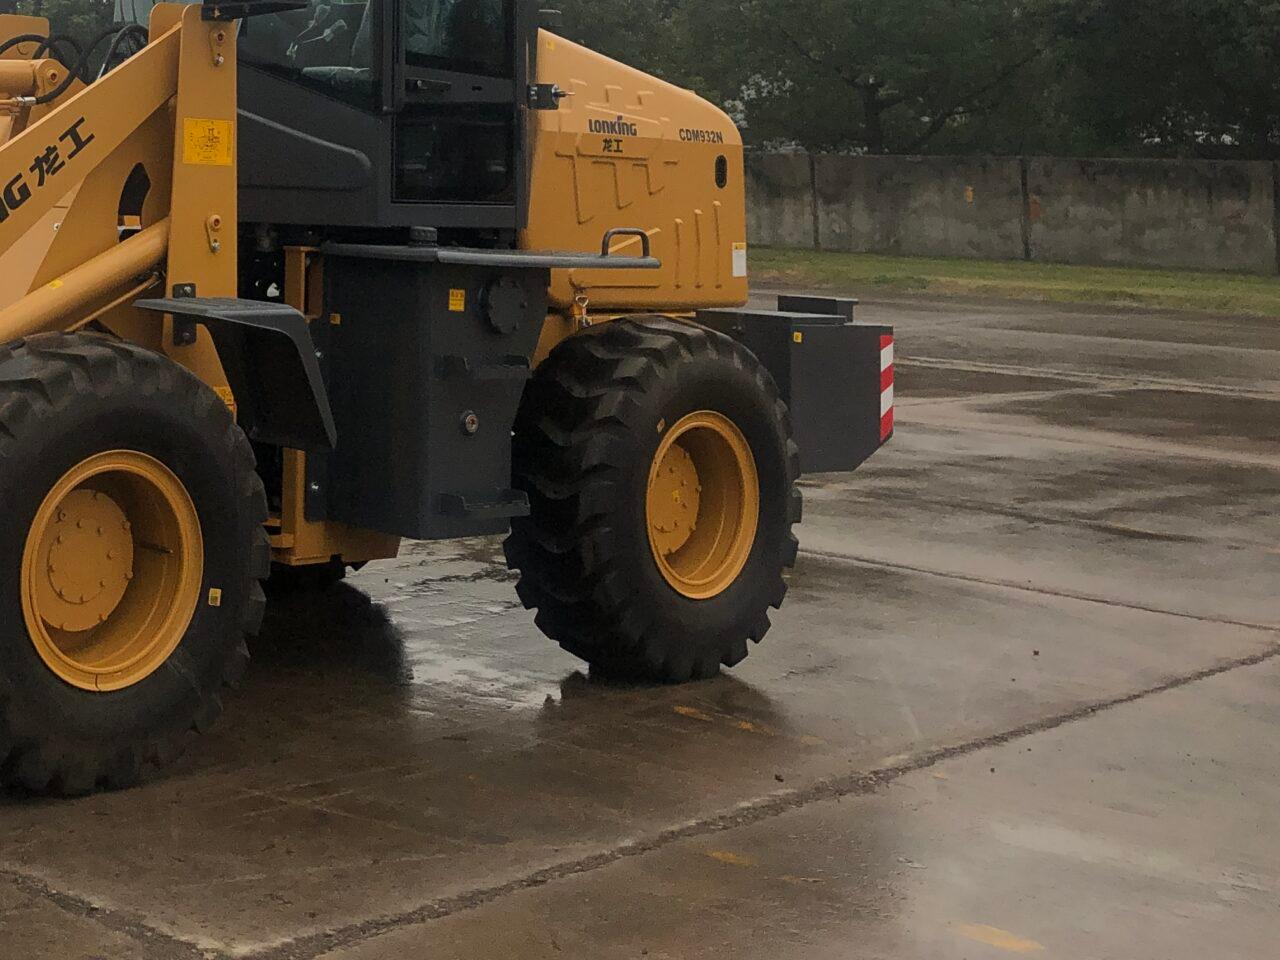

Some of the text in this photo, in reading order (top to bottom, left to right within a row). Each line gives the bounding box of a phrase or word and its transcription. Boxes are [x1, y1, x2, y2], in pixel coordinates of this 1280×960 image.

[678, 127, 724, 144] CDM932N
[29, 116, 96, 187] 龙工
[602, 138, 624, 153] 龙工
